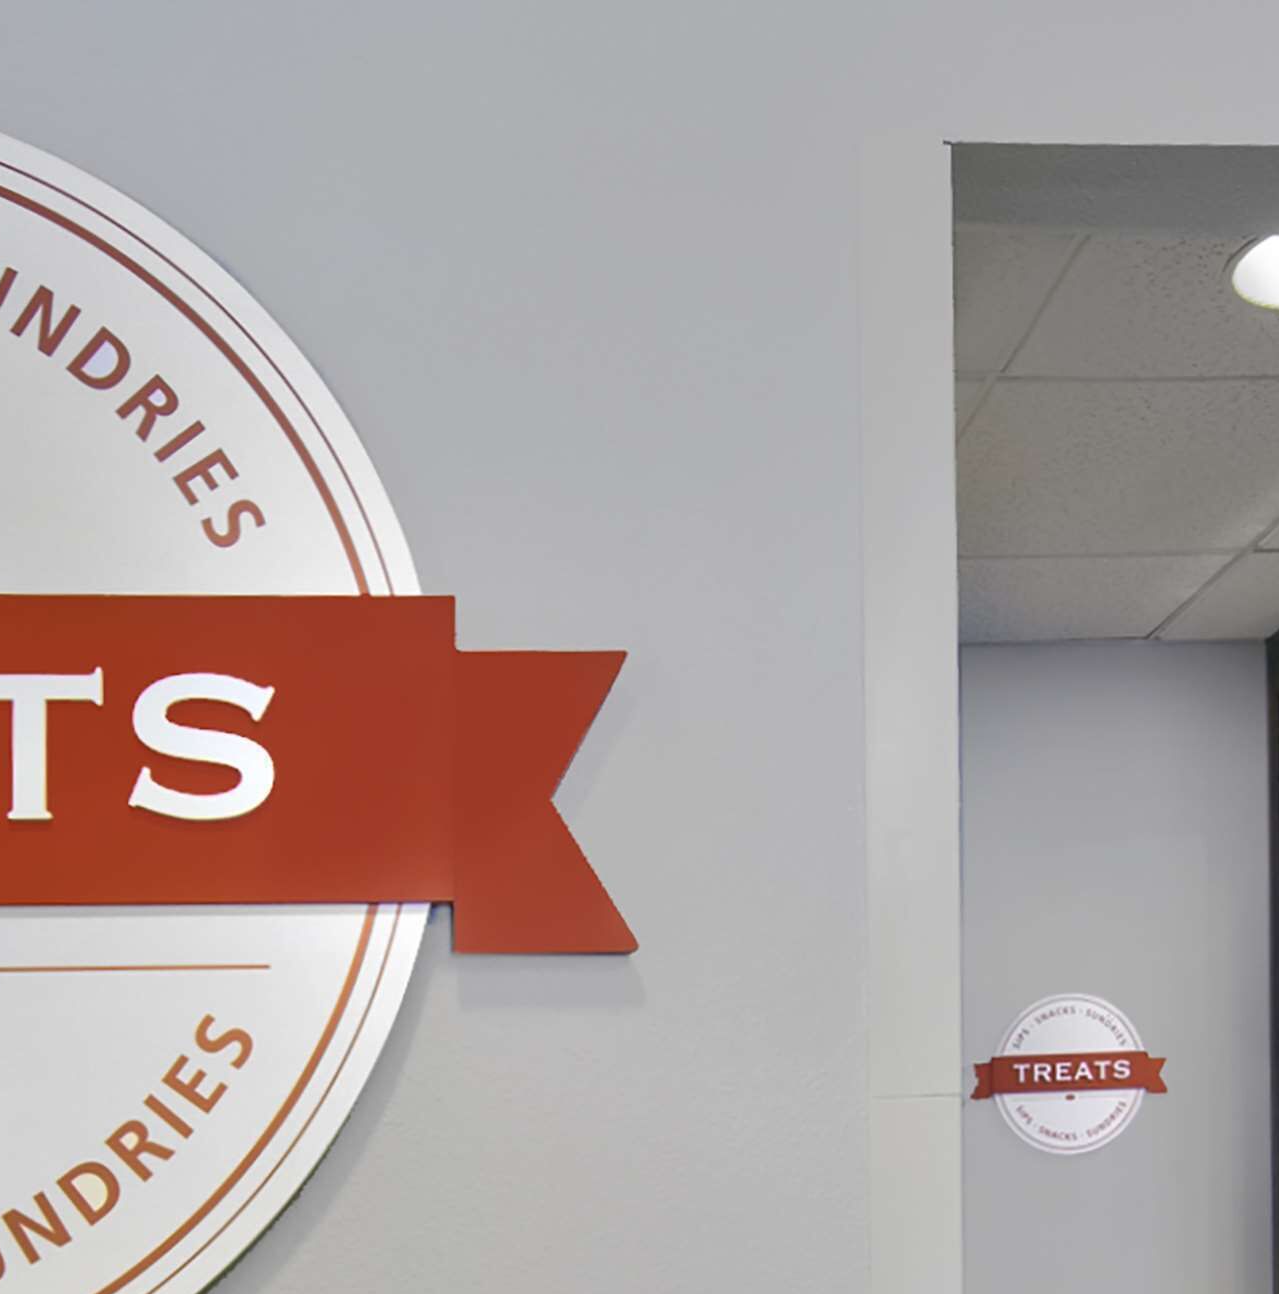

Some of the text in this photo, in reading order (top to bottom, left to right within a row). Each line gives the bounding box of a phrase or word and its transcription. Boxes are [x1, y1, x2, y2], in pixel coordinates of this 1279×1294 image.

[1035, 1006, 1076, 1025] SNACKS
[1086, 1008, 1126, 1046] SUNDRIES
[1013, 1060, 1131, 1084] TREATS
[1086, 1101, 1127, 1137] SUNDRIES
